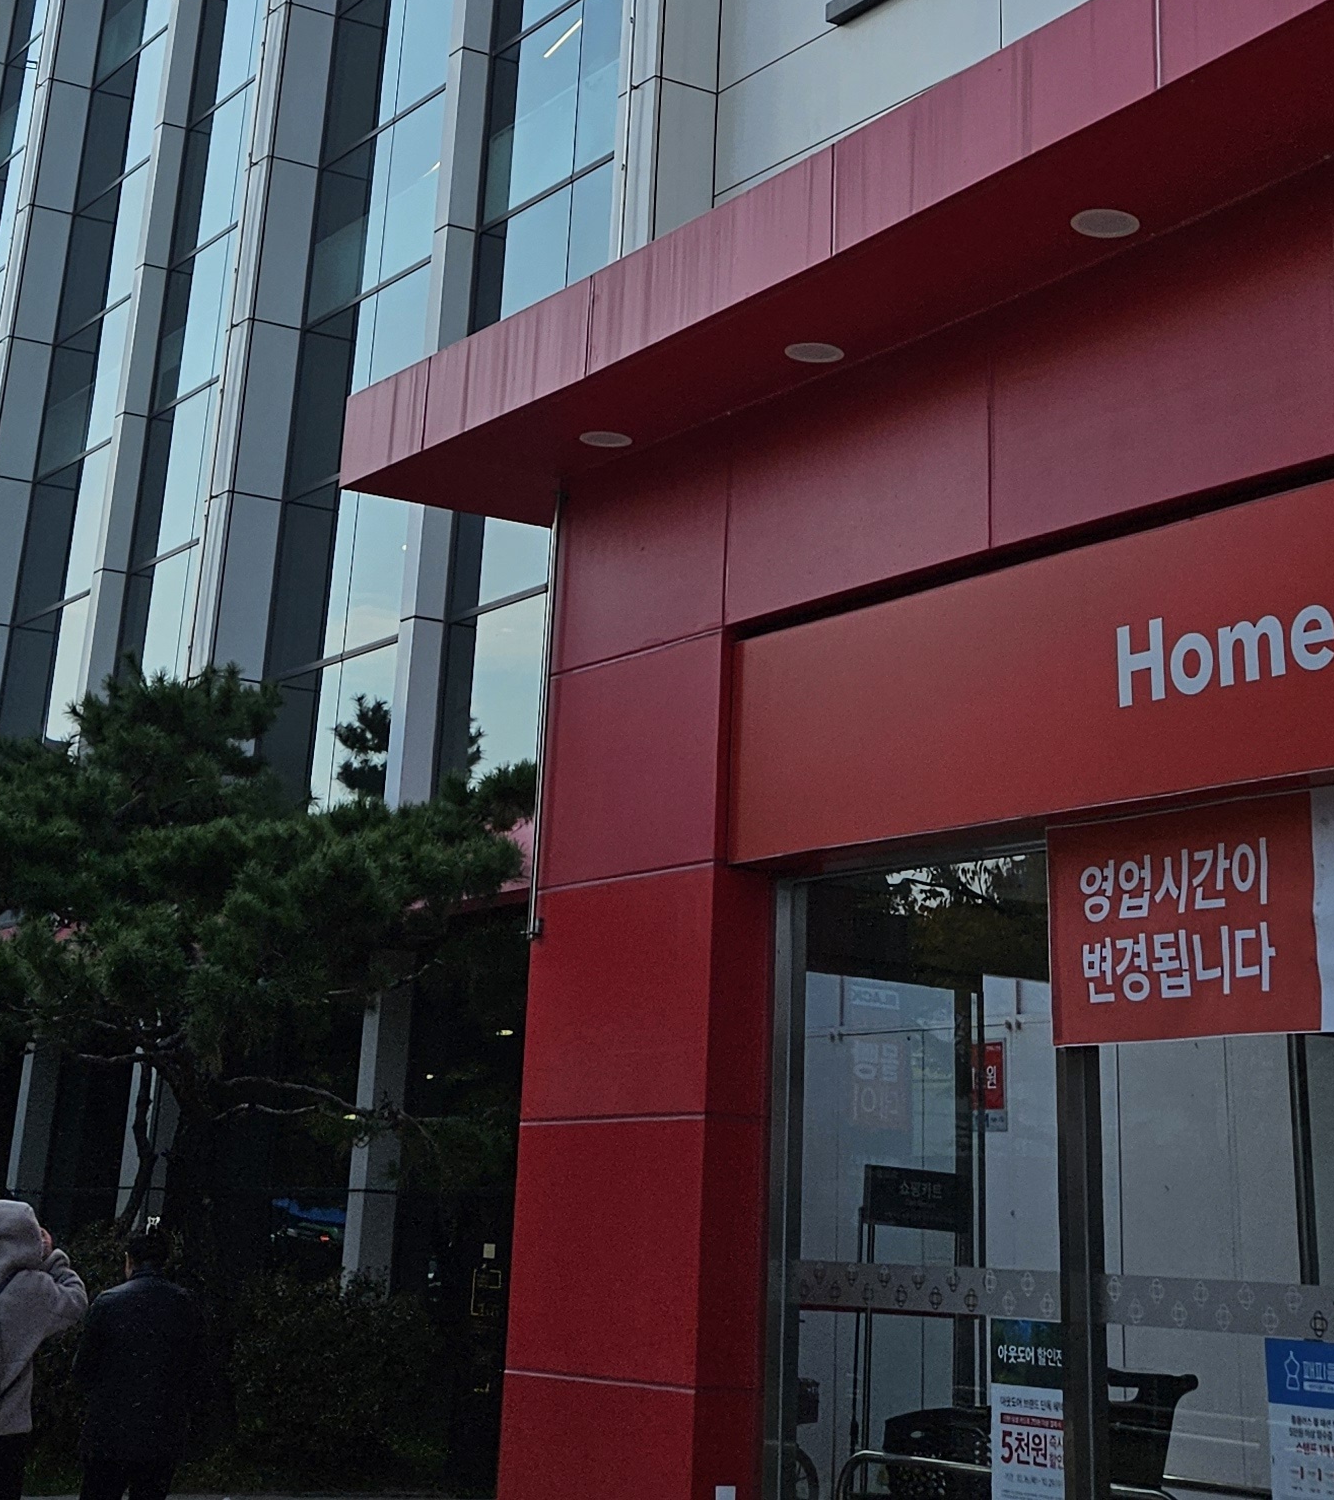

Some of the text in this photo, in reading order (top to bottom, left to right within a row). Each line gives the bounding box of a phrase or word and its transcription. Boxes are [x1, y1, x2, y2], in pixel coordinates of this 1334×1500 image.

[1079, 837, 1268, 922] 영업시간이
[1082, 921, 1276, 1003] 변경됩니다
[899, 1180, 943, 1200] 쇼핑카트
[997, 1344, 1035, 1365] 아웃도어
[1000, 1430, 1048, 1468] 5천원
